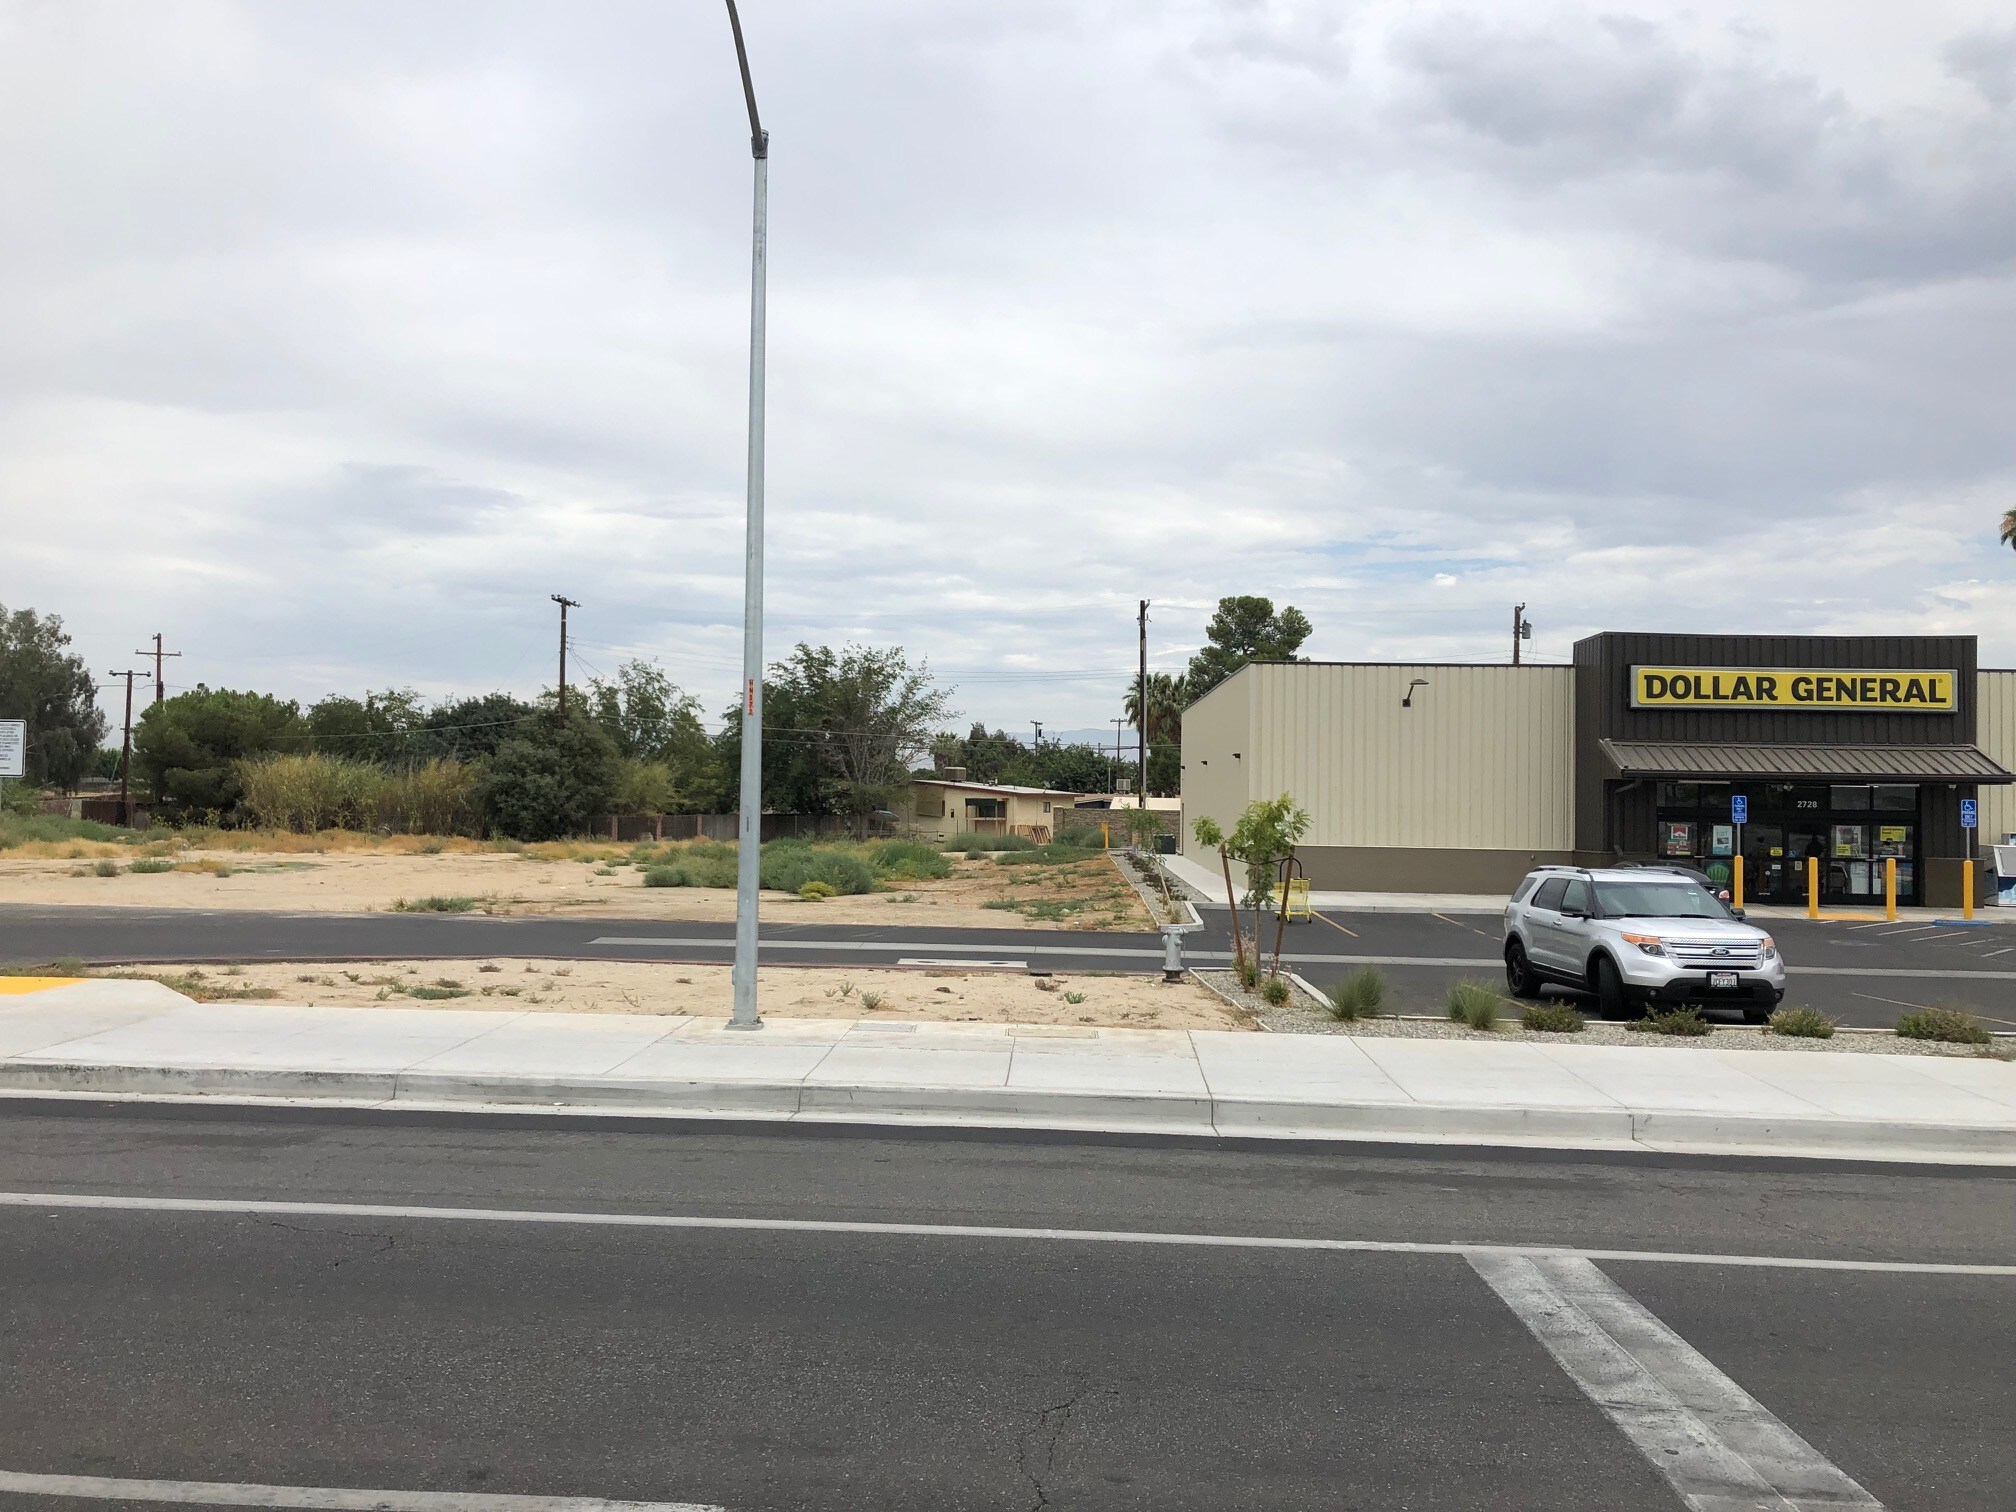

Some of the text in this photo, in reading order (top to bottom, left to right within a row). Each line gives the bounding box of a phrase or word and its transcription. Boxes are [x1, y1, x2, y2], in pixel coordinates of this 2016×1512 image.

[1644, 674, 1947, 704] DOLLAR GENERAL
[1797, 800, 1818, 808] 2728
